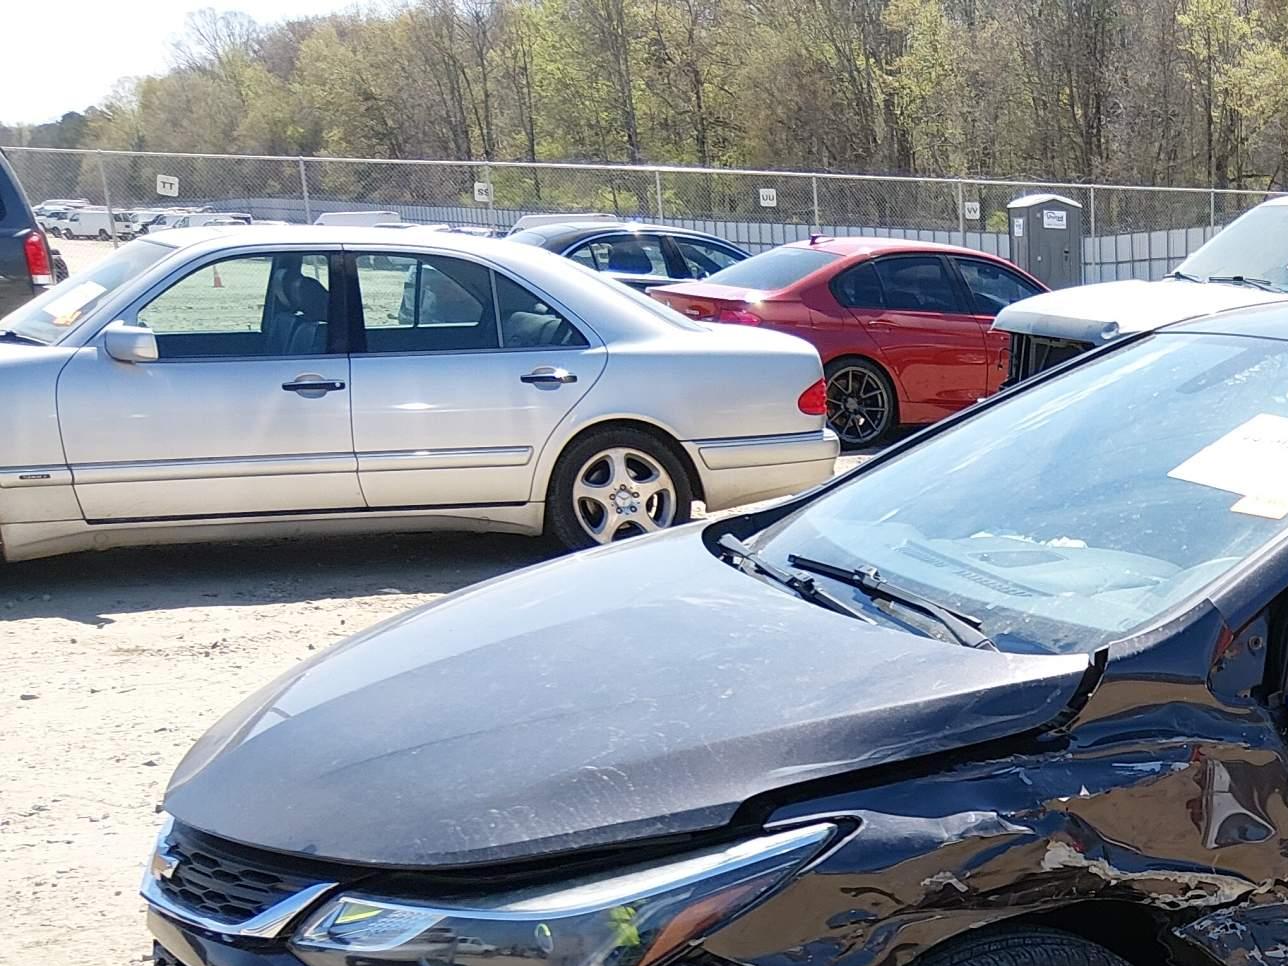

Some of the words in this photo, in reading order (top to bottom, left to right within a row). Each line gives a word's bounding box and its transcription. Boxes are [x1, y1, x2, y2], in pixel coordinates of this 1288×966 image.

[160, 181, 175, 190] TT
[478, 188, 489, 196] SS
[761, 194, 775, 202] UU
